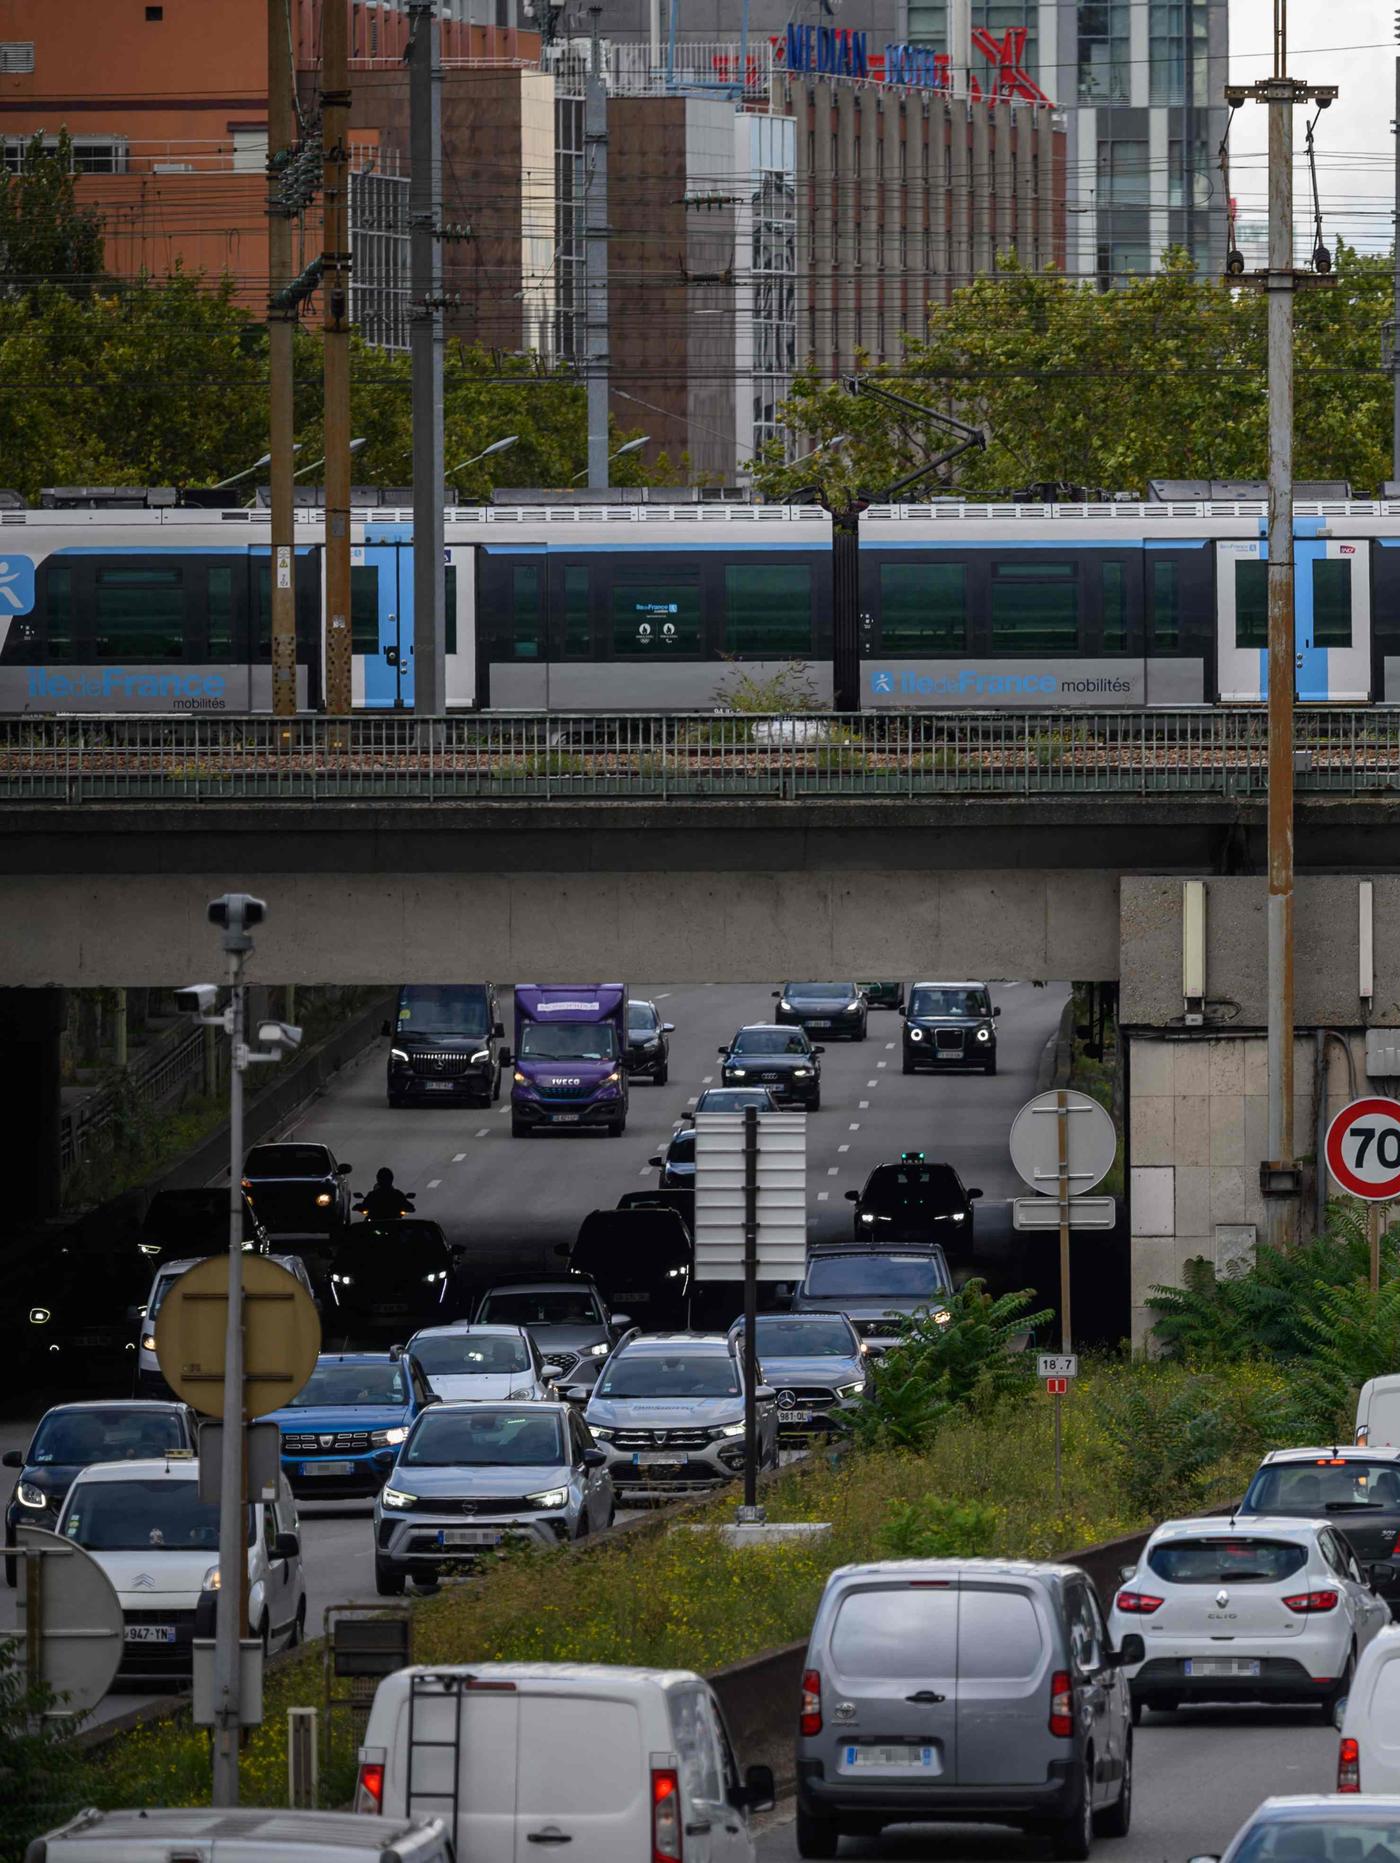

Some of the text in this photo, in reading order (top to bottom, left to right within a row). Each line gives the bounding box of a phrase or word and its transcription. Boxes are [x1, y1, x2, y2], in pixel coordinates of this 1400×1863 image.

[1061, 677, 1131, 692] mobilités
[172, 697, 226, 709] mobilités
[552, 1078, 581, 1086] IVECO
[1043, 1359, 1072, 1370] 18.7
